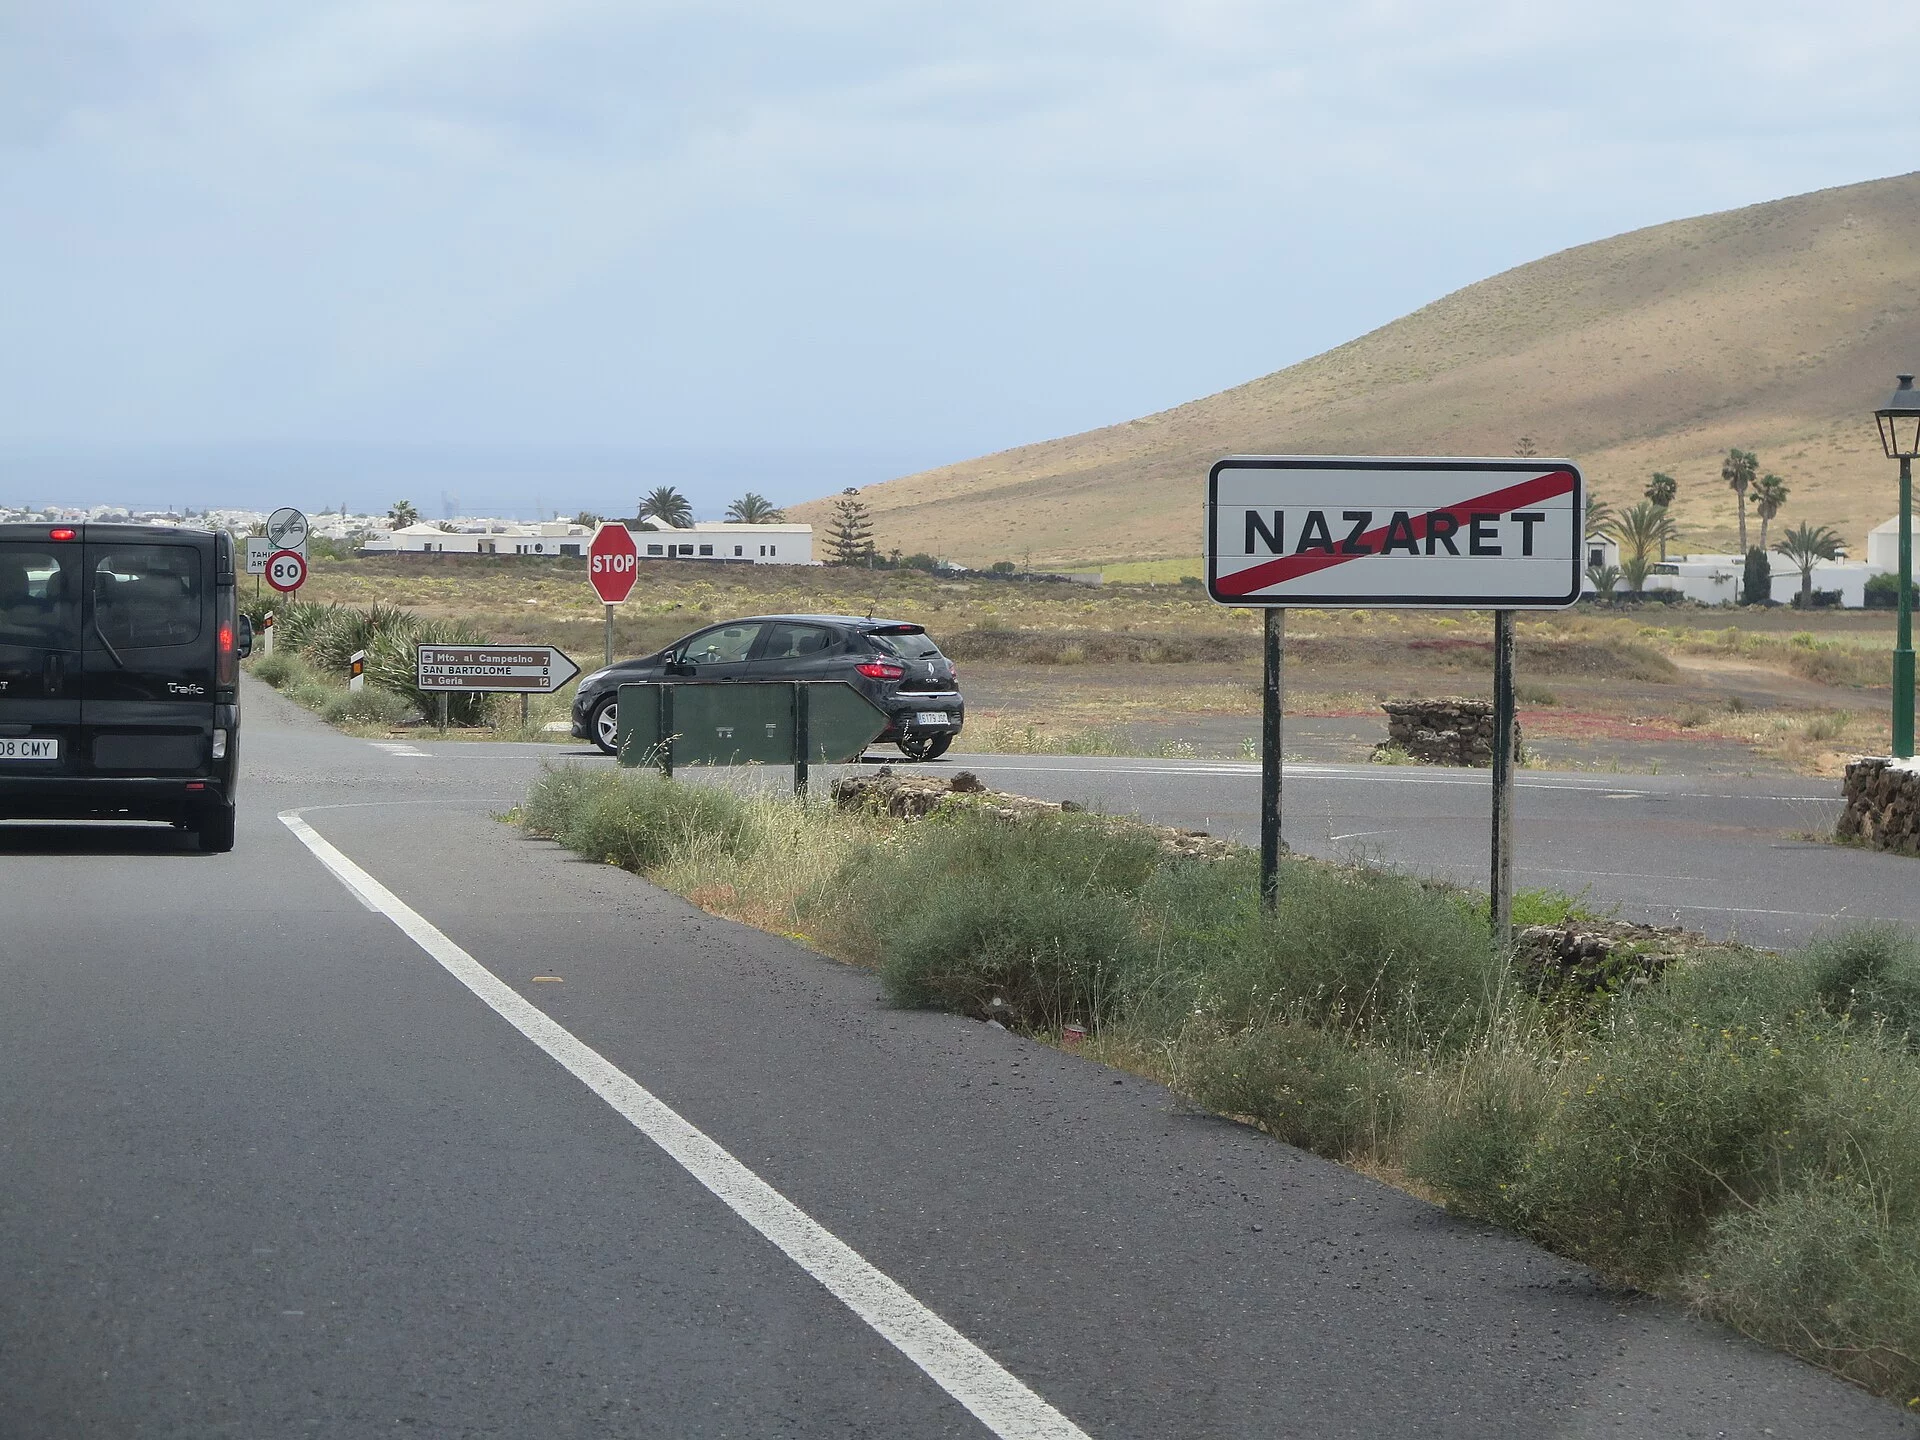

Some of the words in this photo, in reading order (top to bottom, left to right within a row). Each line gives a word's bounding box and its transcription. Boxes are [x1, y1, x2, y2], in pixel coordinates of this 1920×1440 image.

[1244, 510, 1546, 557] NAZARET
[592, 554, 635, 573] STOP
[274, 564, 298, 578] 80
[437, 653, 458, 662] Mto.
[463, 654, 473, 662] al
[479, 653, 533, 665] Campesino
[543, 656, 549, 665] 7
[422, 665, 443, 674] SAN
[542, 667, 549, 675] 8
[422, 676, 433, 684] La
[438, 676, 463, 685] Geria
[538, 677, 549, 686] 12
[167, 682, 205, 695] Trafic
[21, 742, 50, 756] CMY
